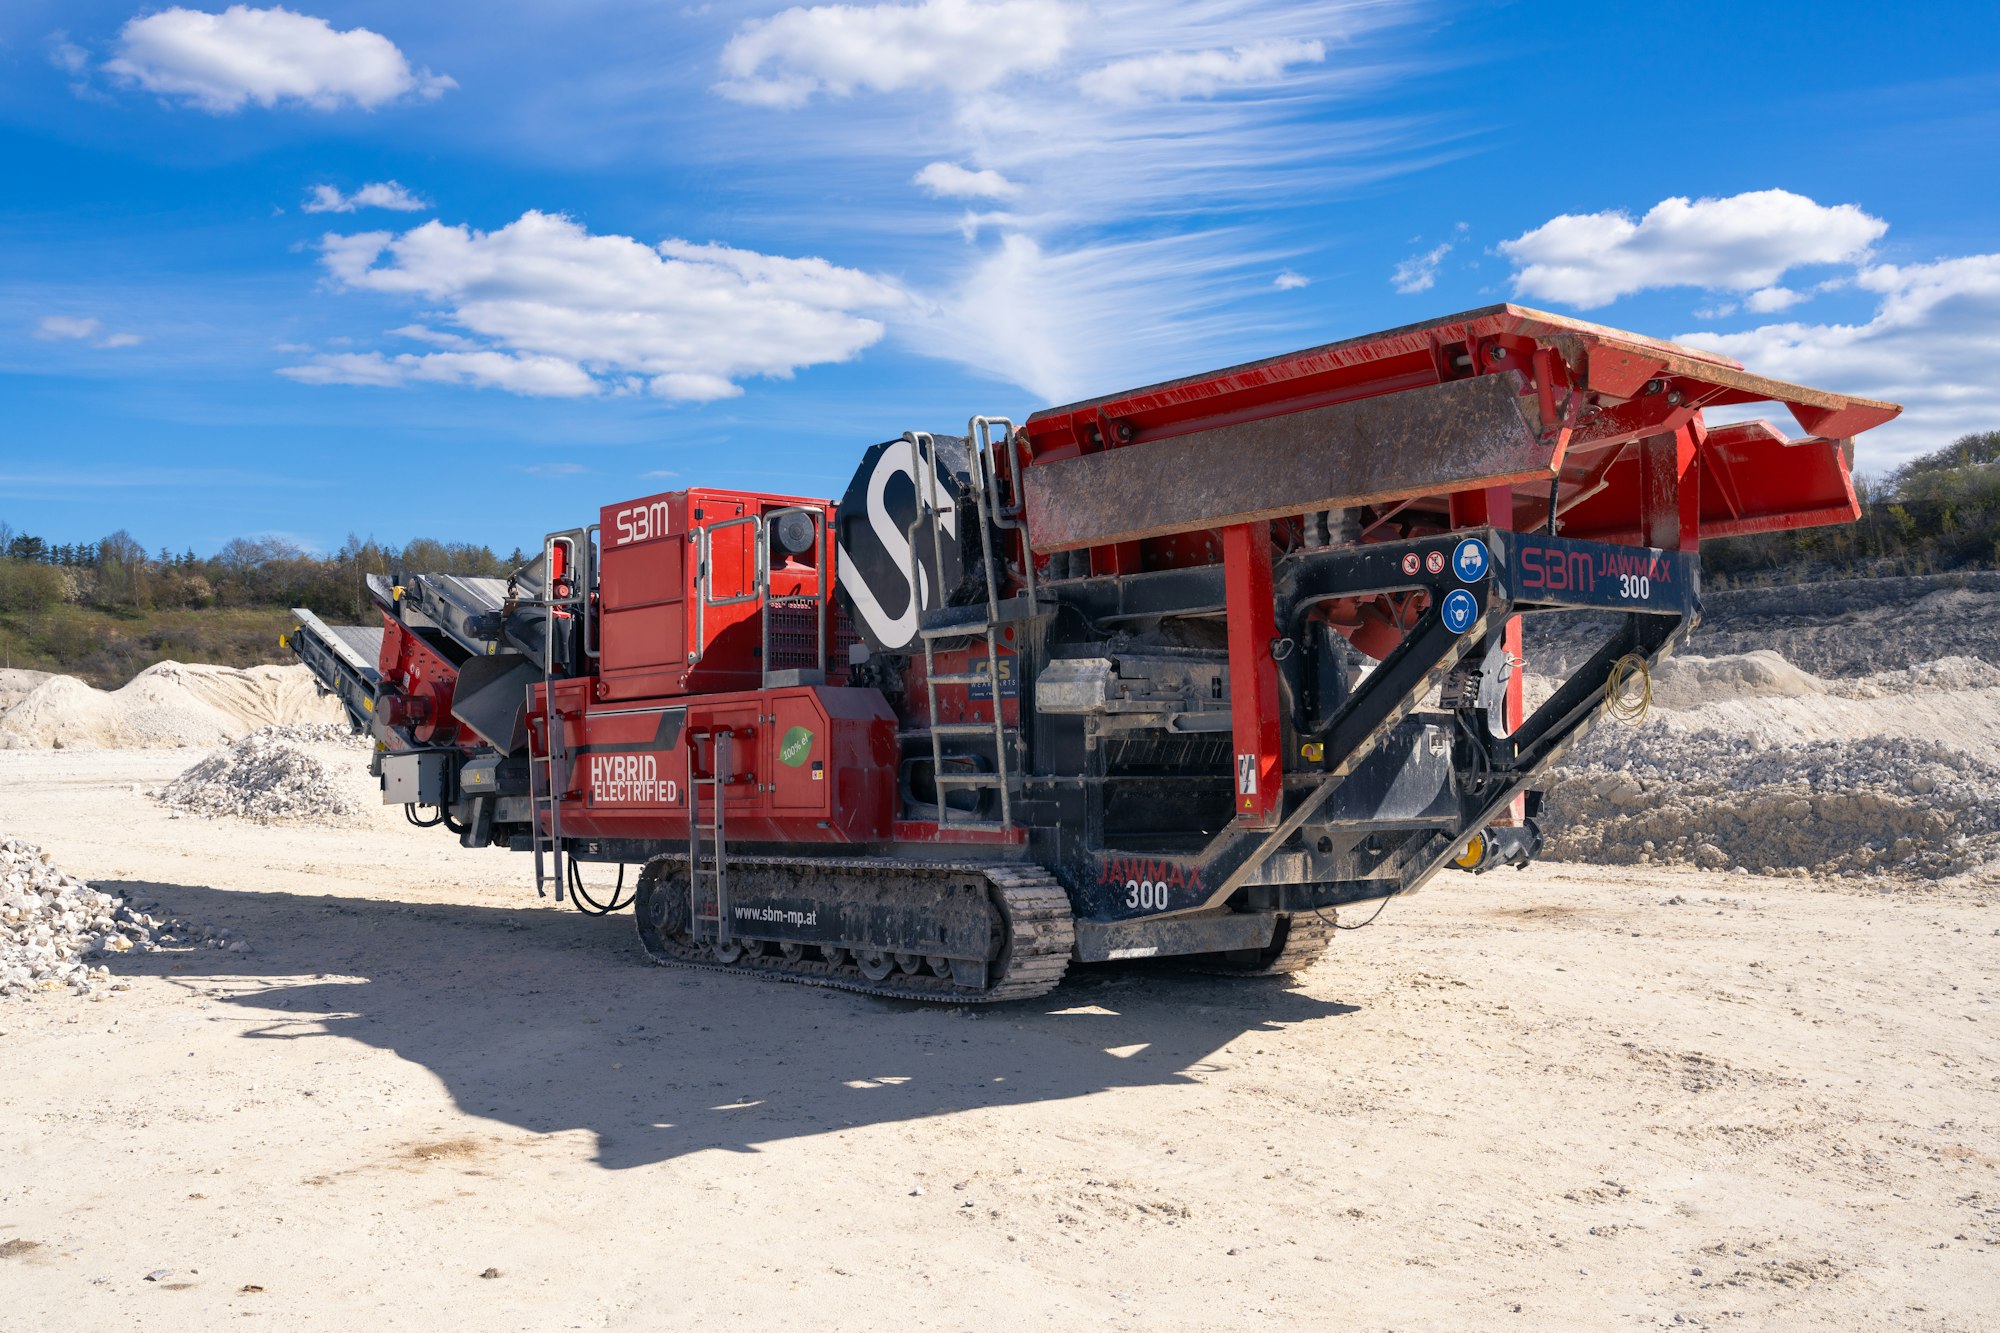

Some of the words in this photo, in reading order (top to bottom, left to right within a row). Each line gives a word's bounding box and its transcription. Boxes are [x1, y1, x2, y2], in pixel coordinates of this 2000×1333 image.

[617, 501, 669, 545] SBM
[1521, 547, 1595, 592] SBM
[1598, 553, 1672, 583] JAWMAX
[1620, 574, 1650, 600] 300
[783, 740, 801, 761] 100%
[591, 755, 657, 786] HYBRID
[594, 781, 677, 802] ELECTRIFIED
[1096, 856, 1204, 892] JAWMAX
[1125, 879, 1168, 910] 300
[735, 906, 817, 927] www.sbm-mp.at
